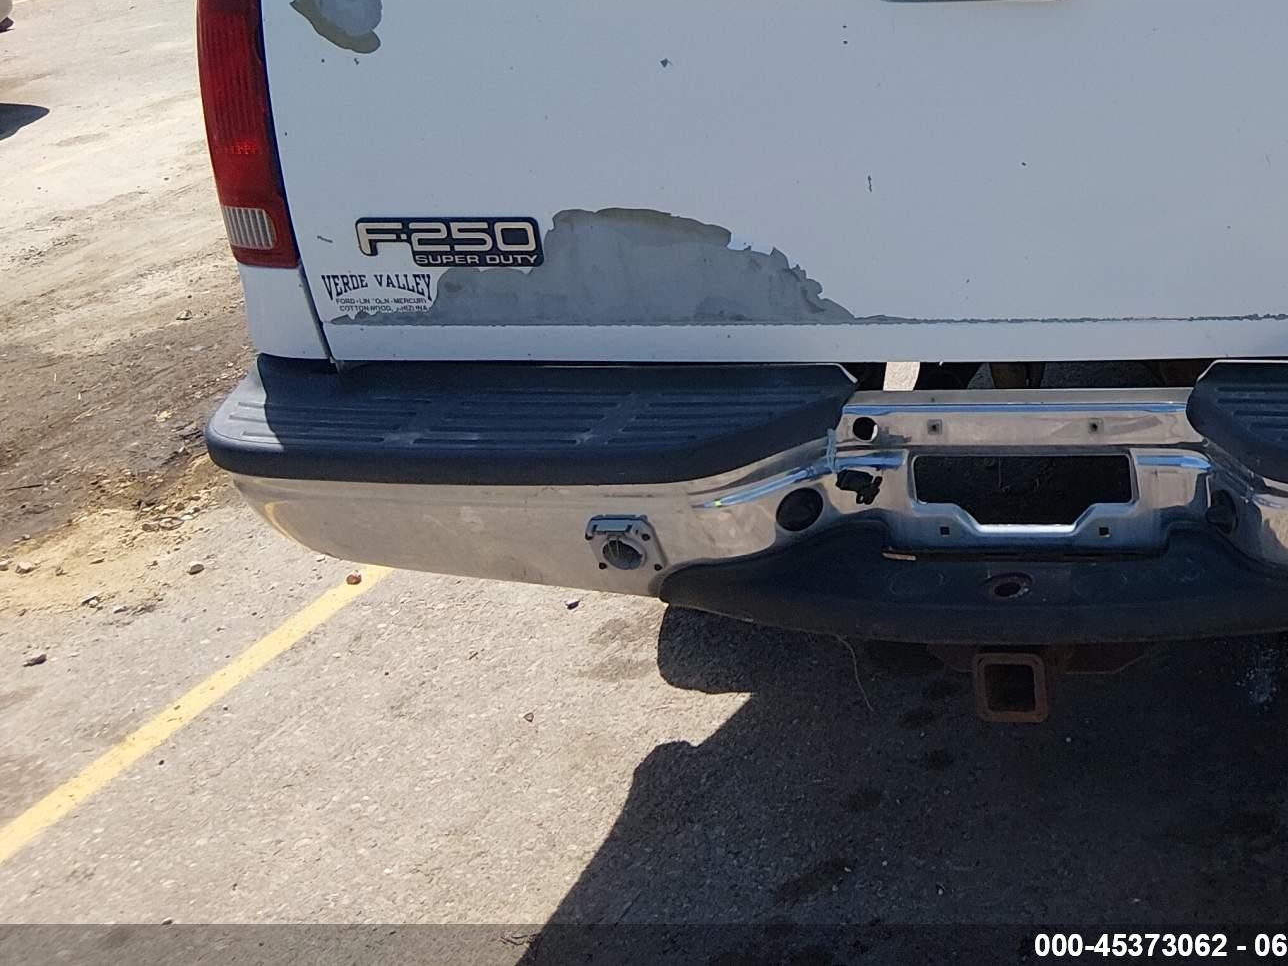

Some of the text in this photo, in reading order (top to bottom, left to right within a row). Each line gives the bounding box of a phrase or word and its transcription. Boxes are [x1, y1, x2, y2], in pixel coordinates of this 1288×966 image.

[357, 221, 537, 256] F-250
[415, 253, 539, 265] SUPER DUTY
[320, 273, 433, 302] VERDE VALLEY
